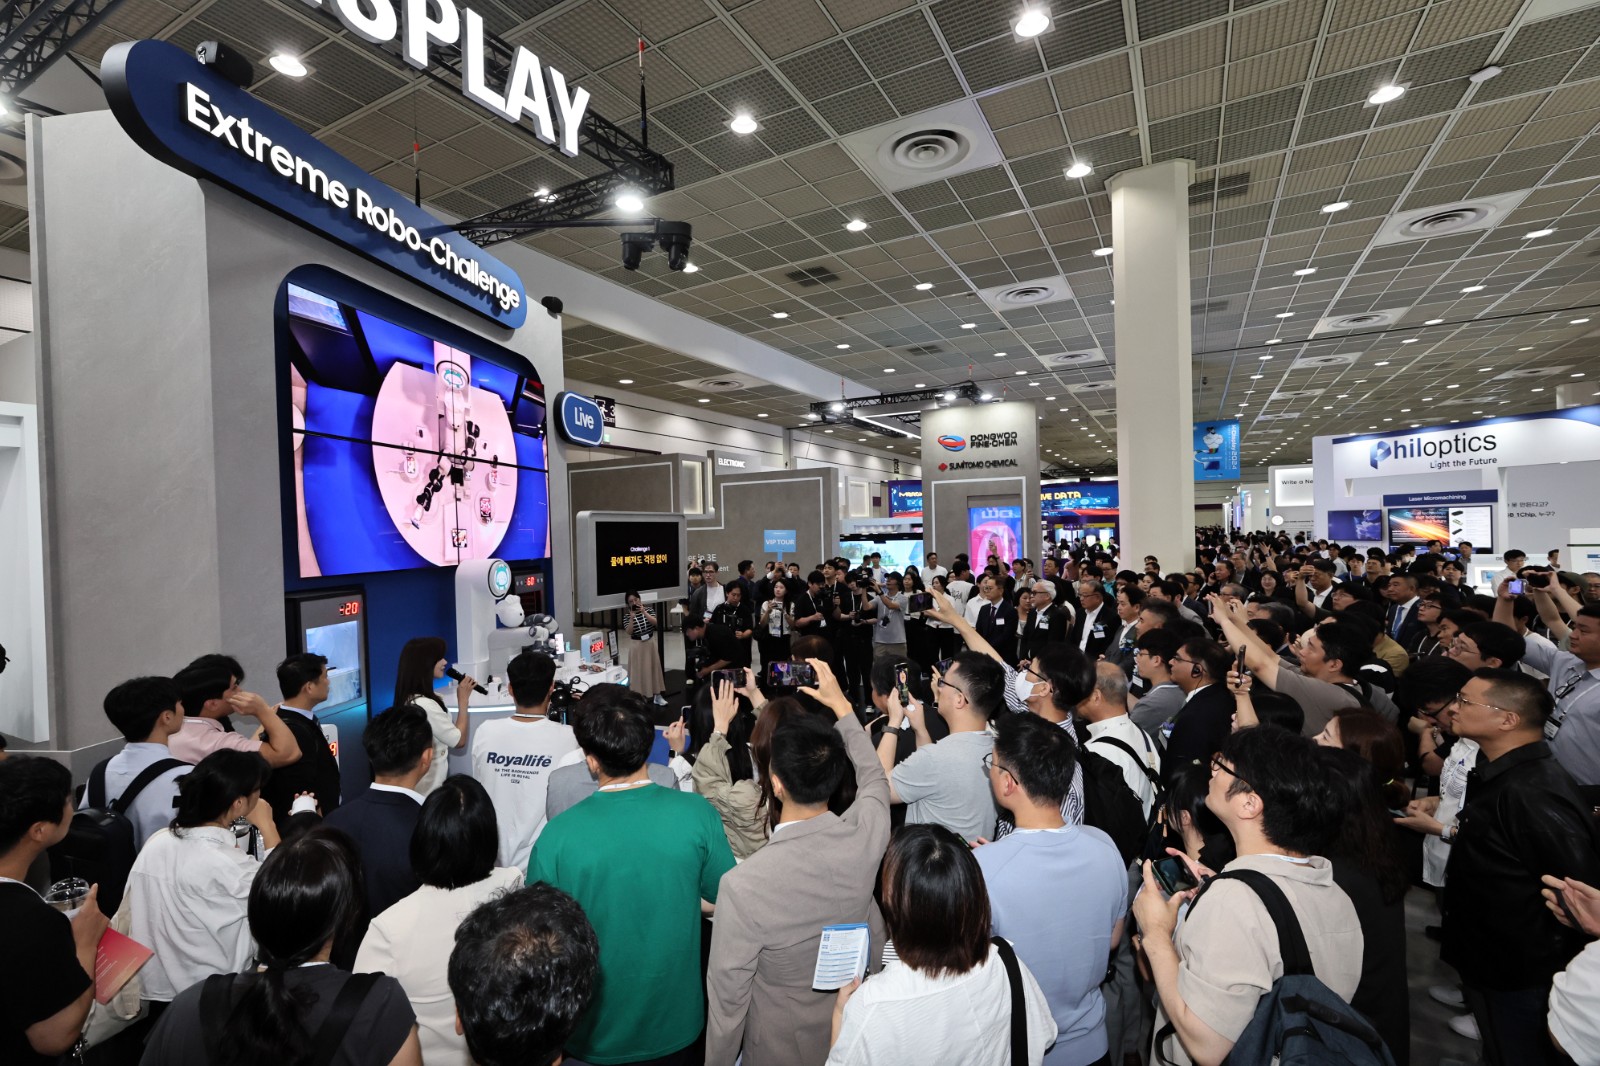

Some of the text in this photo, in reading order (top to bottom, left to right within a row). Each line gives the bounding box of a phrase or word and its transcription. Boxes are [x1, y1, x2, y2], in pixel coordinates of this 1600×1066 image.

[185, 81, 521, 311] Extreme Robo-Challenge
[574, 406, 595, 430] Live
[970, 431, 1018, 441] DONGWOO
[1370, 432, 1497, 470] Philoptics
[949, 459, 1018, 470] SUMITOMO CHEMICAL
[1430, 456, 1498, 470] Light the Future
[1054, 491, 1082, 500] DATA
[486, 751, 552, 768] Royallife
